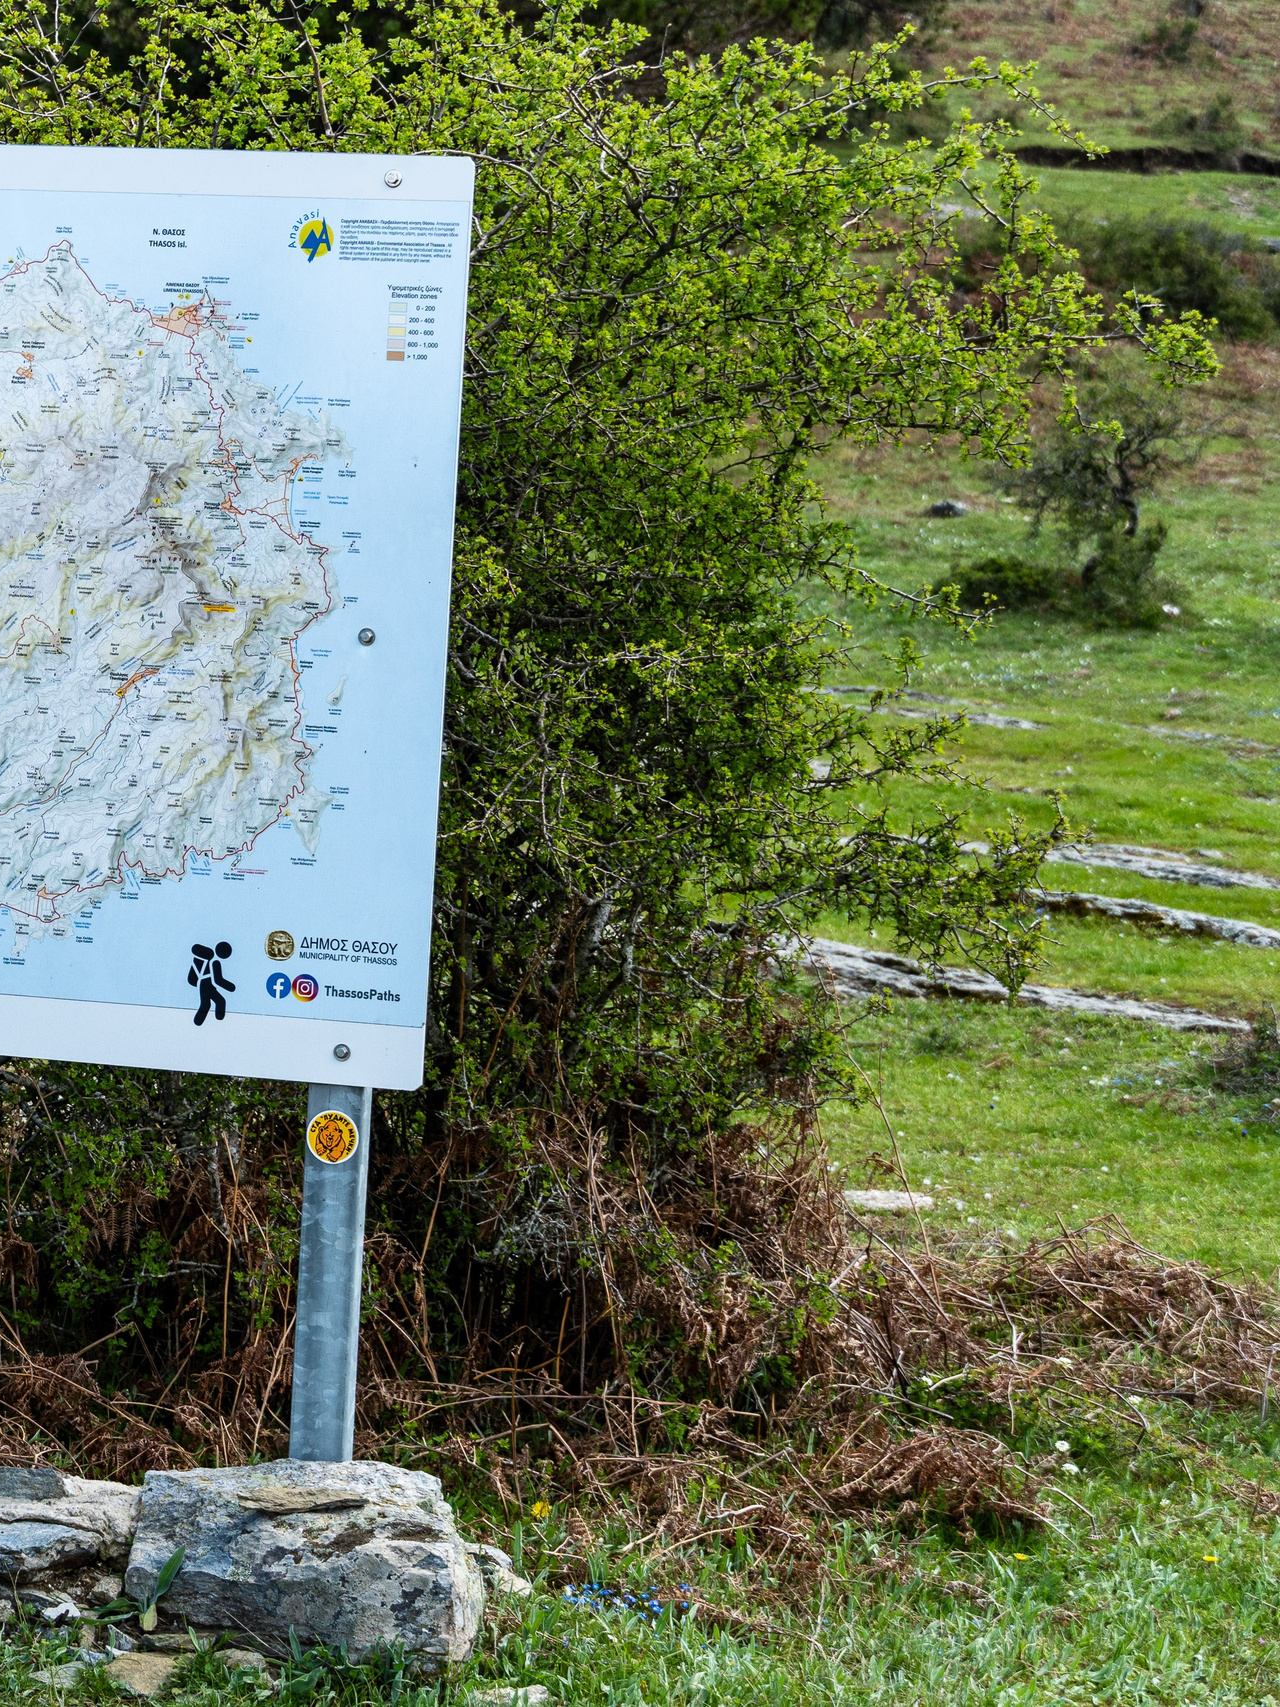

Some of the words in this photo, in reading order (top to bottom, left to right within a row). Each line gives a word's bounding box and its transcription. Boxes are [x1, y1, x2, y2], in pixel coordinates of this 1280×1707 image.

[162, 228, 185, 236] ΘΑΣΟΣ
[288, 210, 320, 248] Anavasi
[149, 240, 176, 248] THASOS
[300, 936, 348, 951] ΔΗΜΟΣ
[352, 940, 398, 955] ΘΑΣΟΥ
[300, 951, 349, 961] MUNICIPALITY
[363, 956, 397, 966] THASSOS
[324, 985, 400, 1002] ThassosPaths
